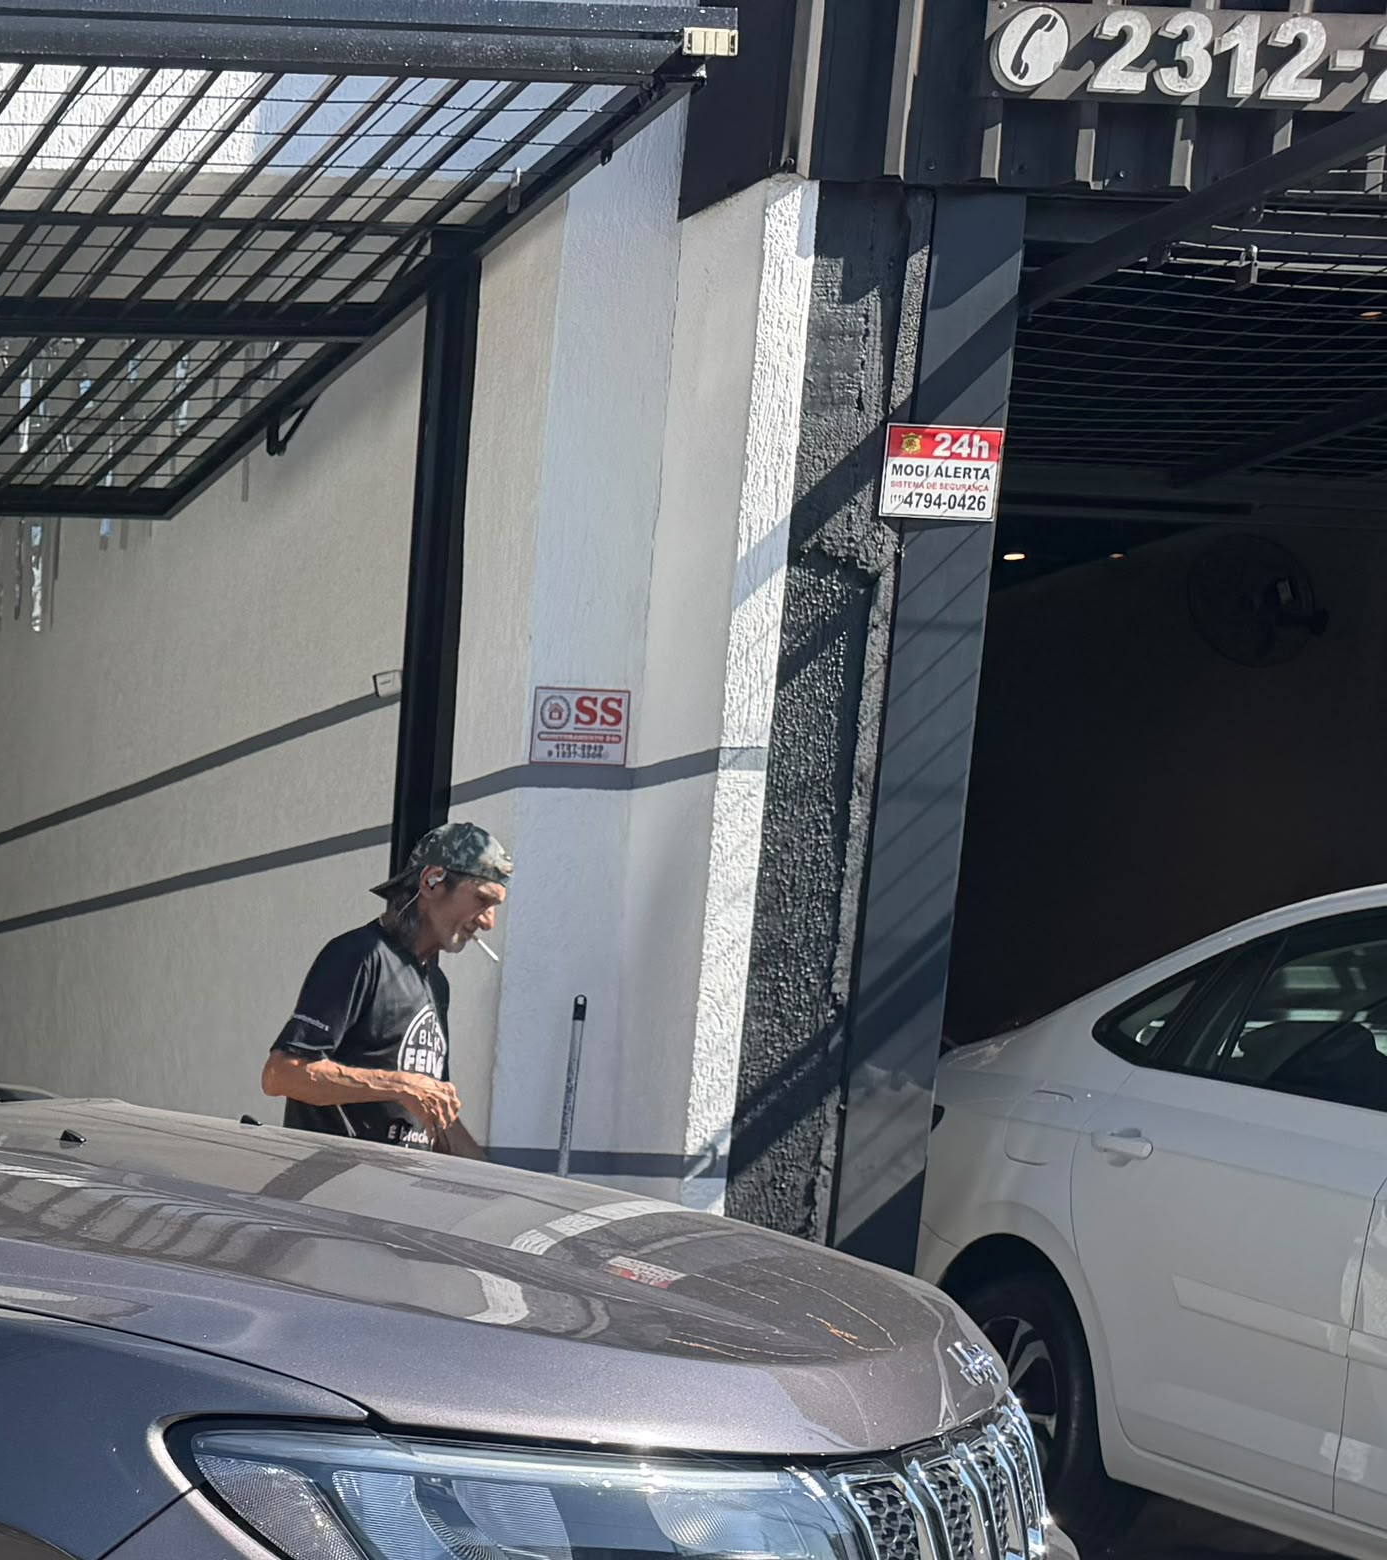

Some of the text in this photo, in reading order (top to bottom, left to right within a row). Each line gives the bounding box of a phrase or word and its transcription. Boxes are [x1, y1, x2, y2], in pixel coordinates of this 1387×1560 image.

[932, 432, 990, 459] 24h
[891, 463, 991, 480] MOGI ALERTA
[890, 480, 990, 493] SISTEMA DE SEGURANÇA
[574, 695, 623, 727] SS
